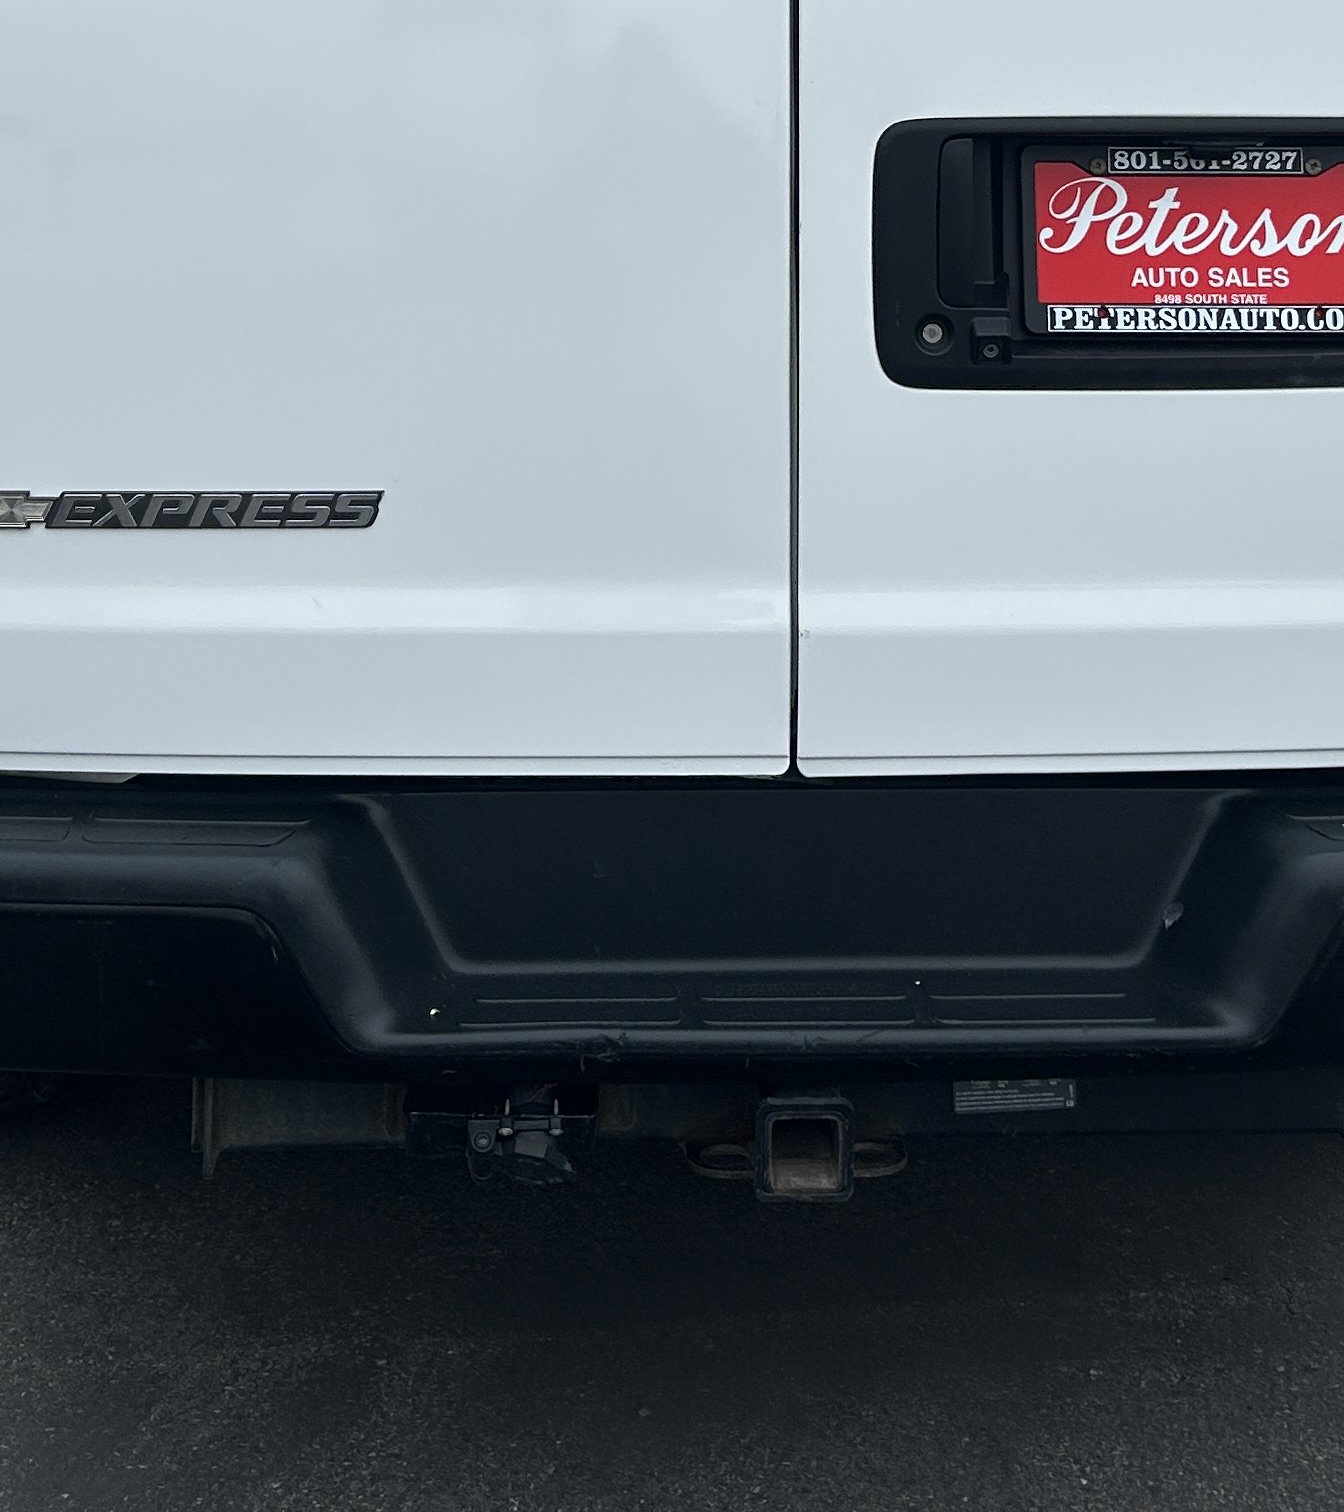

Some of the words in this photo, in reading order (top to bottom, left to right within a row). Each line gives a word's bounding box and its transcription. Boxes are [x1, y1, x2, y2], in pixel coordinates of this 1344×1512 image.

[1131, 267, 1199, 287] AUTO
[1207, 267, 1290, 287] SALES
[1154, 293, 1182, 305] 8498
[1185, 293, 1227, 305] SOUTH
[1230, 293, 1268, 305] STATE
[58, 492, 380, 527] EXPRESS
